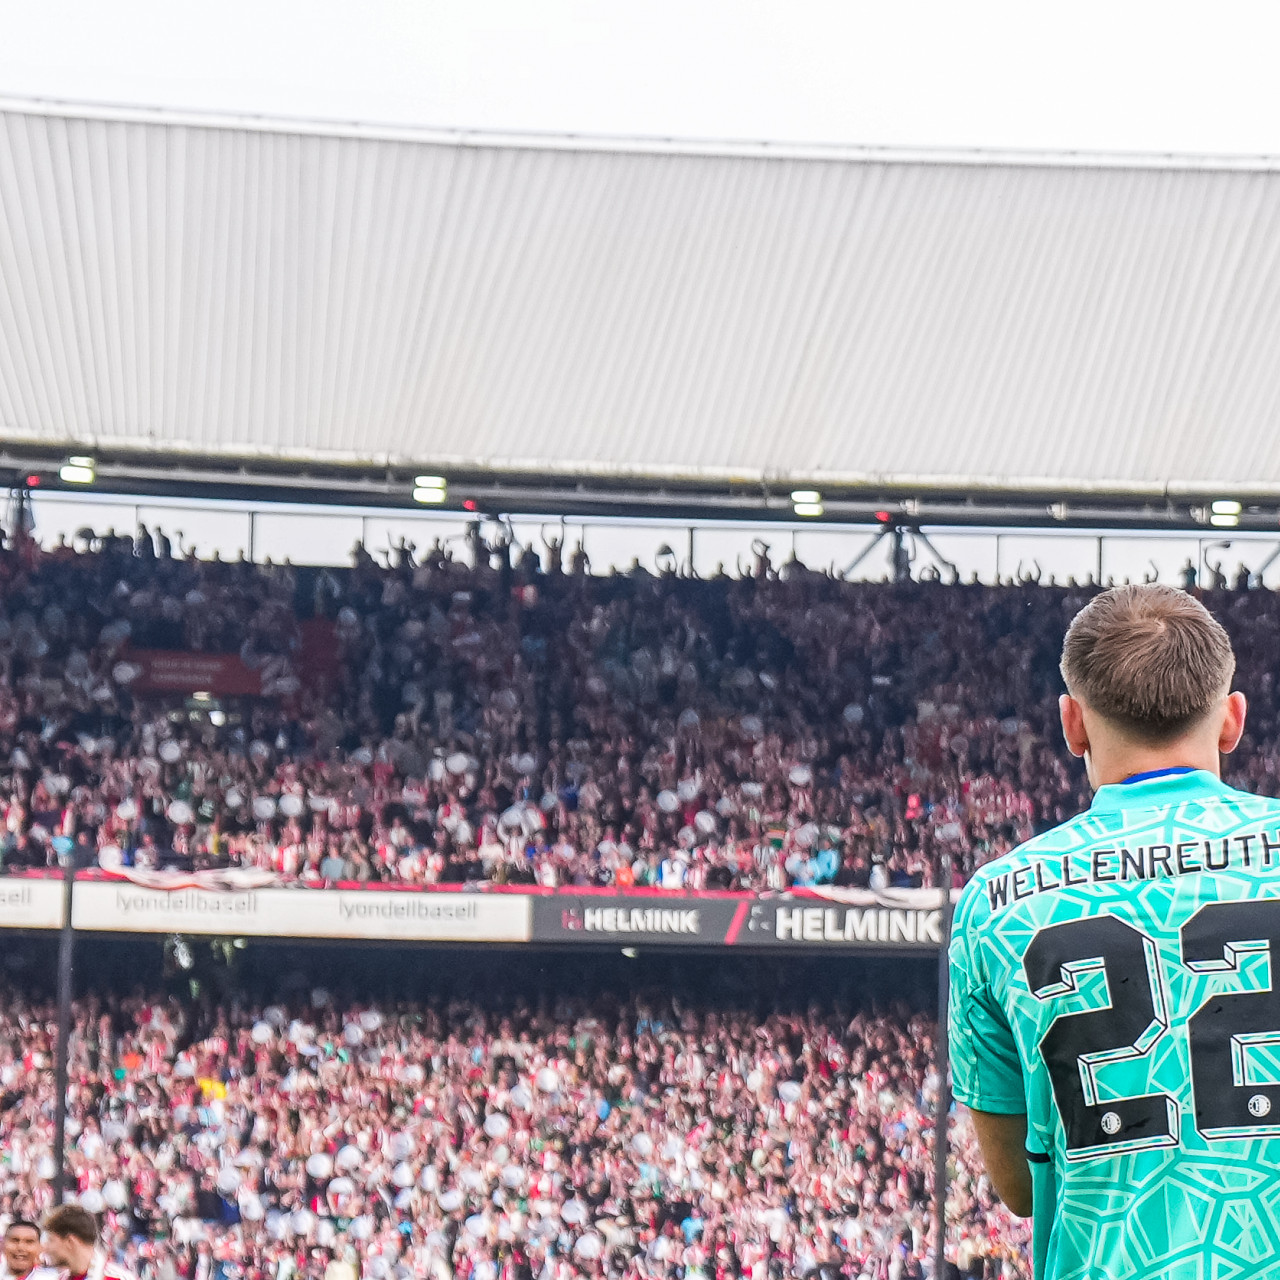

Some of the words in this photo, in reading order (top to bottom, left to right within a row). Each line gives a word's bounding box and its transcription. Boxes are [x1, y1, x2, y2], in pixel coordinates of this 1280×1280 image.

[338, 896, 477, 921] lyondellbasell
[584, 907, 698, 933] HELMINK
[775, 906, 943, 944] HELMINK
